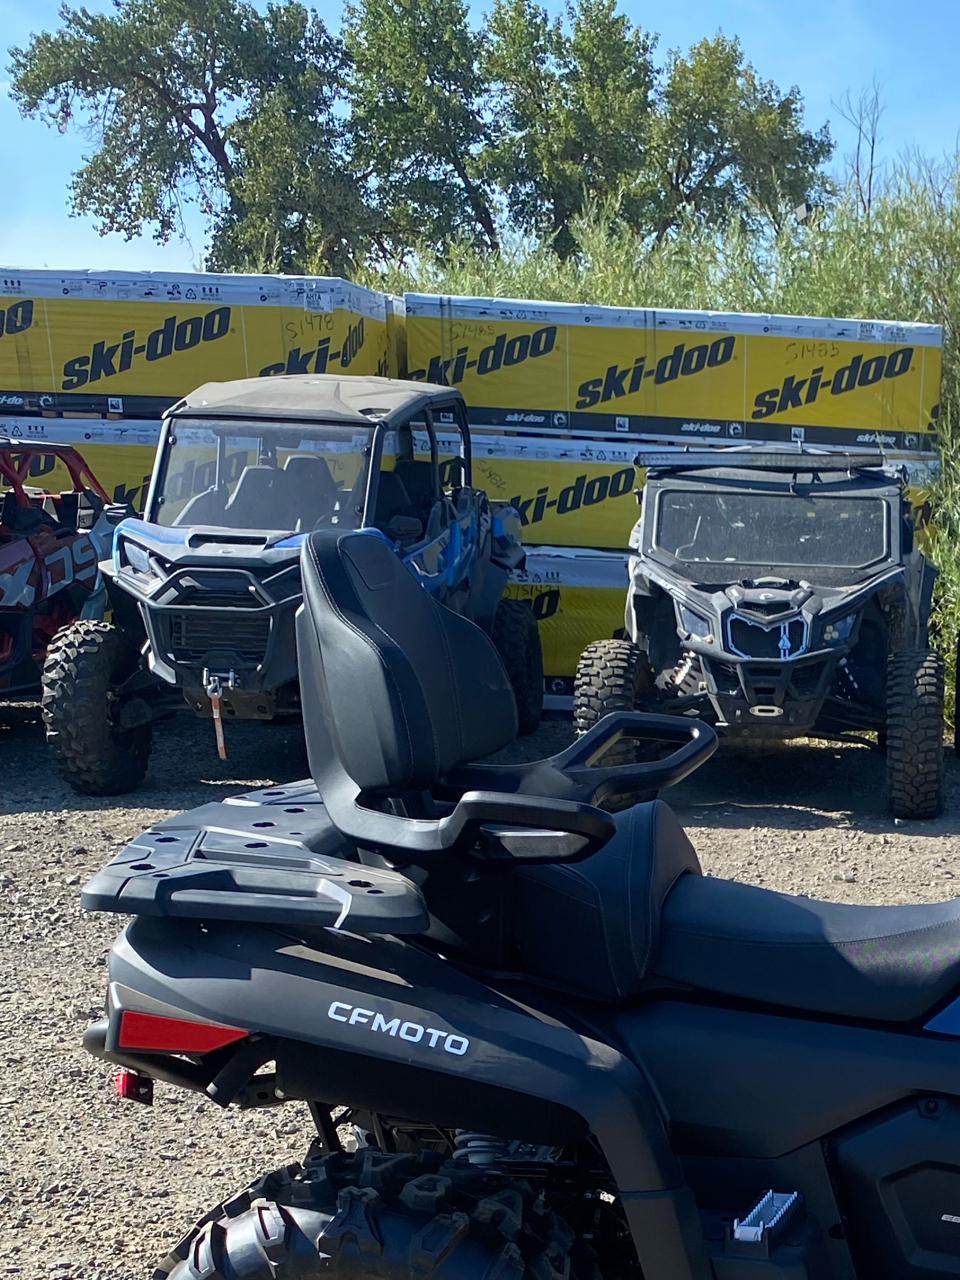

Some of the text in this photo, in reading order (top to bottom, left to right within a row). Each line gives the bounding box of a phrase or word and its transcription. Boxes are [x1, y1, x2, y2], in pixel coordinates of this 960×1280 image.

[62, 306, 231, 390] ski-doo
[575, 336, 736, 409] ski-doo
[751, 347, 914, 419] ski-doo
[505, 413, 546, 423] ski-doo
[681, 422, 721, 433] ski-doo
[510, 467, 636, 527] ki-doo
[327, 1001, 470, 1056] CFMOTO
